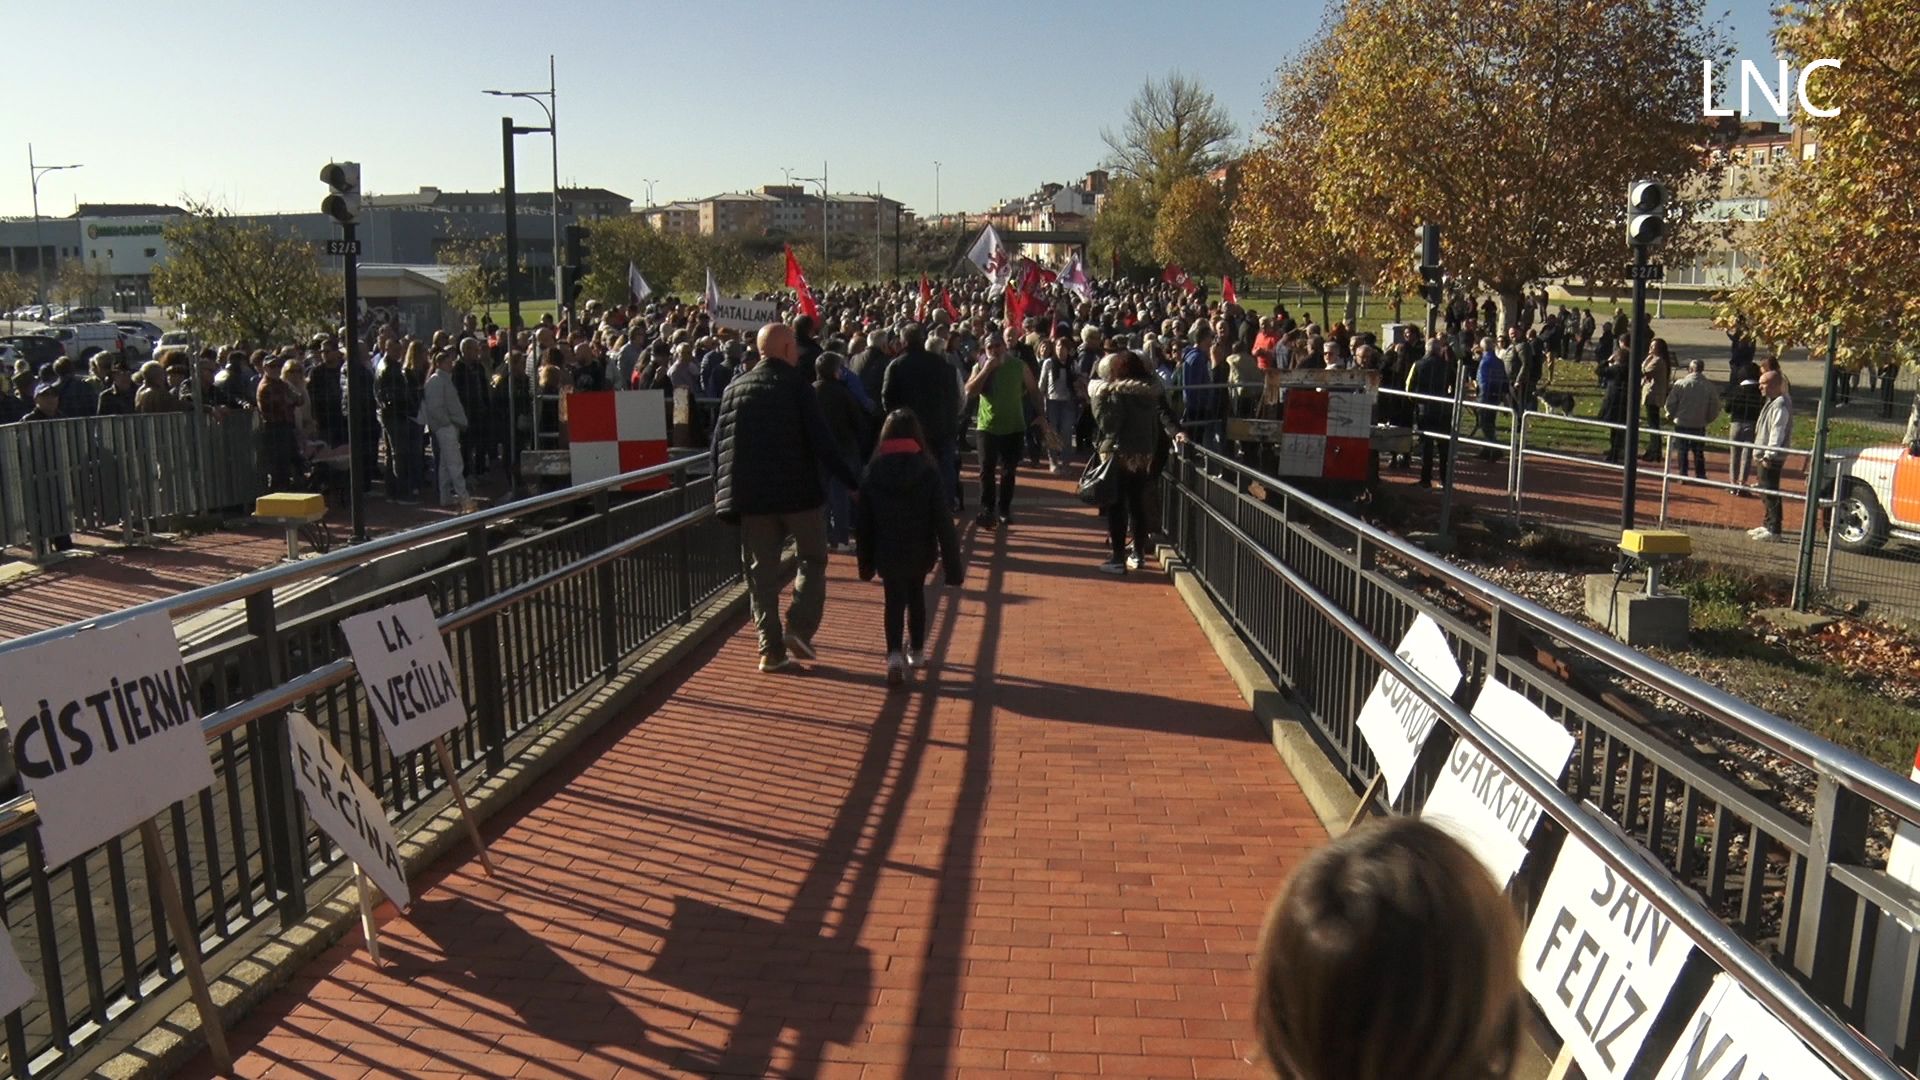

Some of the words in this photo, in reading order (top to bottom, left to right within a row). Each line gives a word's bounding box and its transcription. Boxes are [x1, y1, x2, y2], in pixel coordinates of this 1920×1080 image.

[331, 242, 357, 254] S2/3
[714, 305, 775, 322] MATALLANA
[377, 615, 413, 653] LA
[13, 665, 199, 779] CISTIERNA
[372, 660, 457, 727] VECILLA
[318, 736, 356, 794] LA
[297, 741, 404, 882] ERCINA
[1590, 866, 1671, 967] SAN
[1535, 906, 1648, 1074] FELIZ
